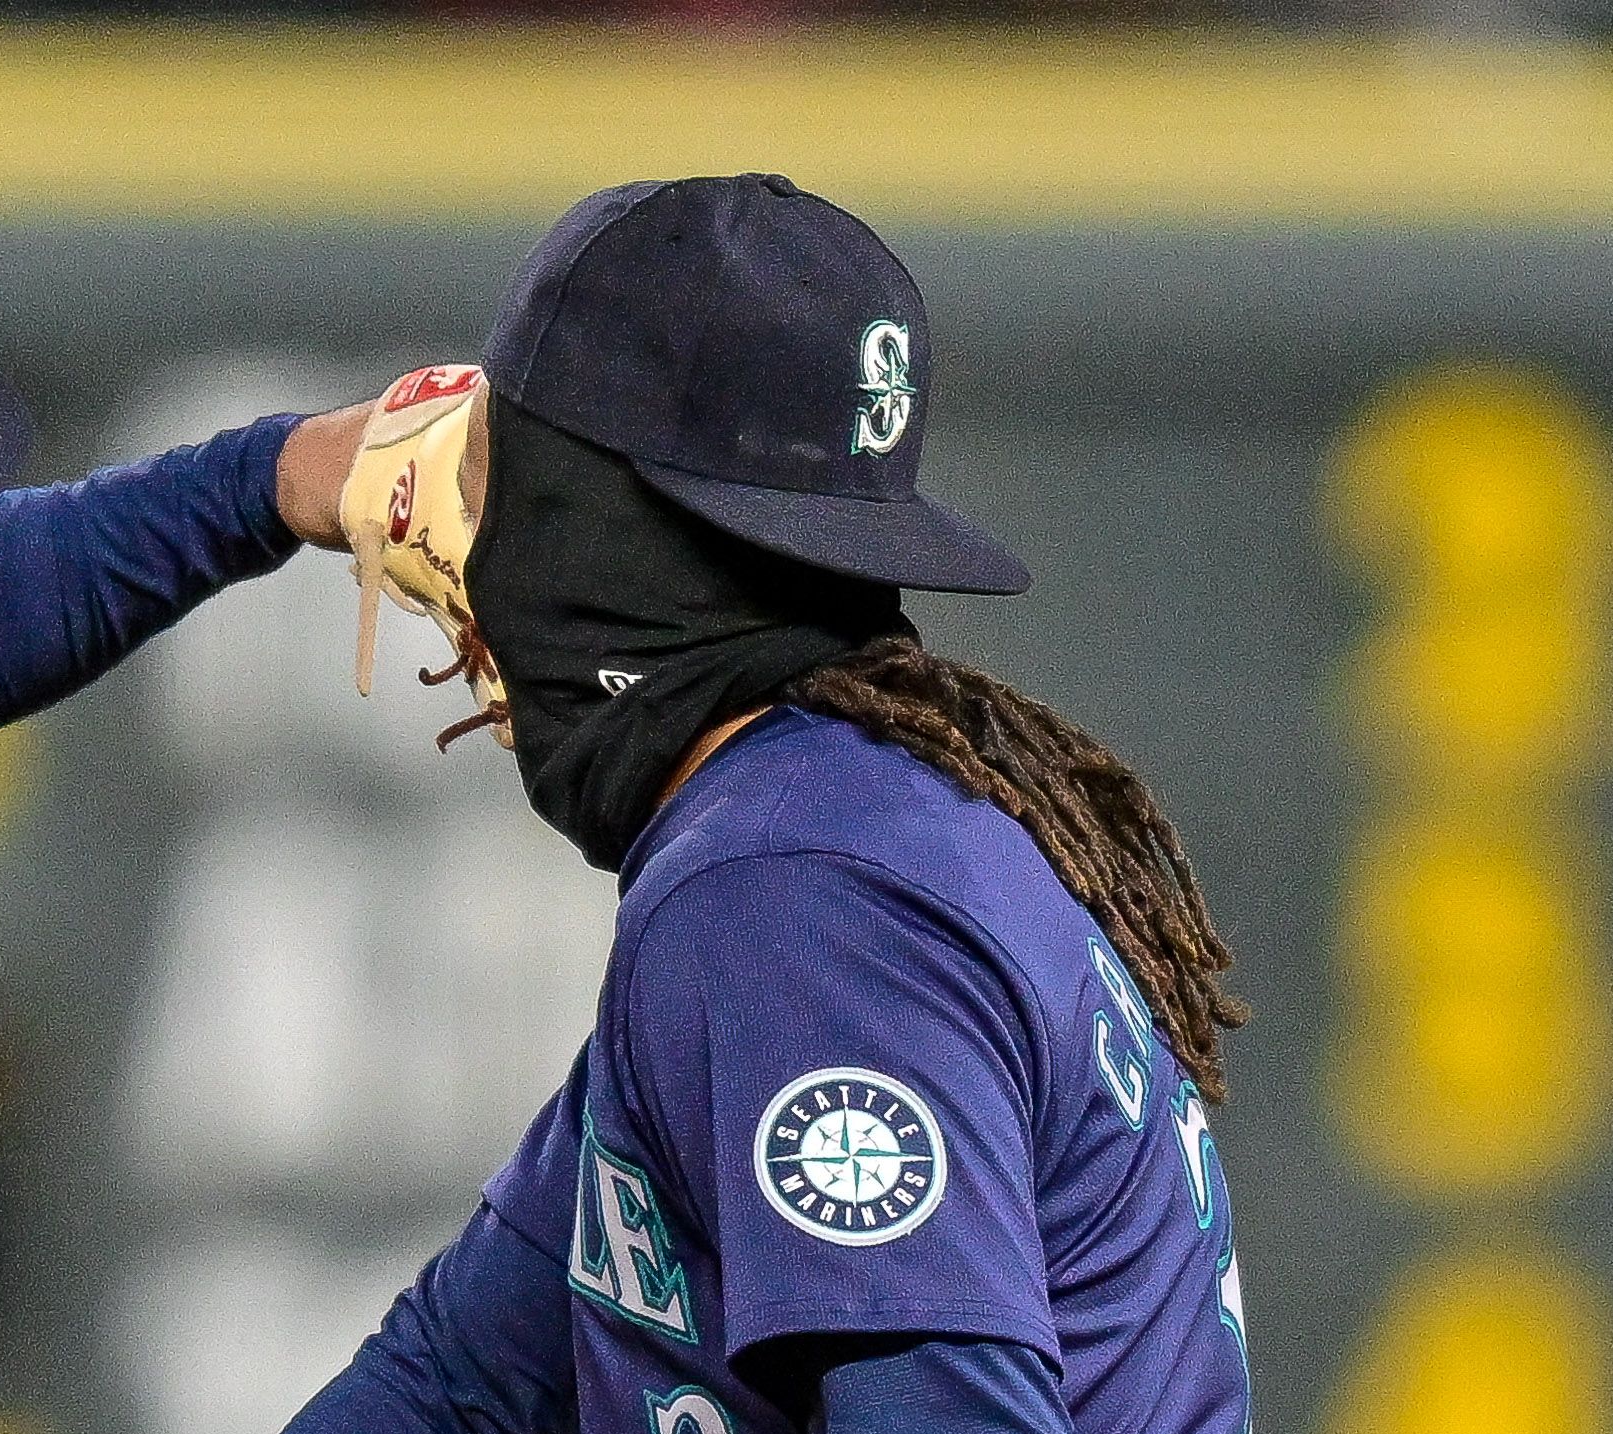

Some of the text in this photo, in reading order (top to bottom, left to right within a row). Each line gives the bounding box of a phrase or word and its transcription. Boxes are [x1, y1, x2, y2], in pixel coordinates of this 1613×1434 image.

[850, 318, 916, 457] S
[776, 1085, 920, 1142] SEATTLE
[779, 1170, 927, 1227] MARINERS
